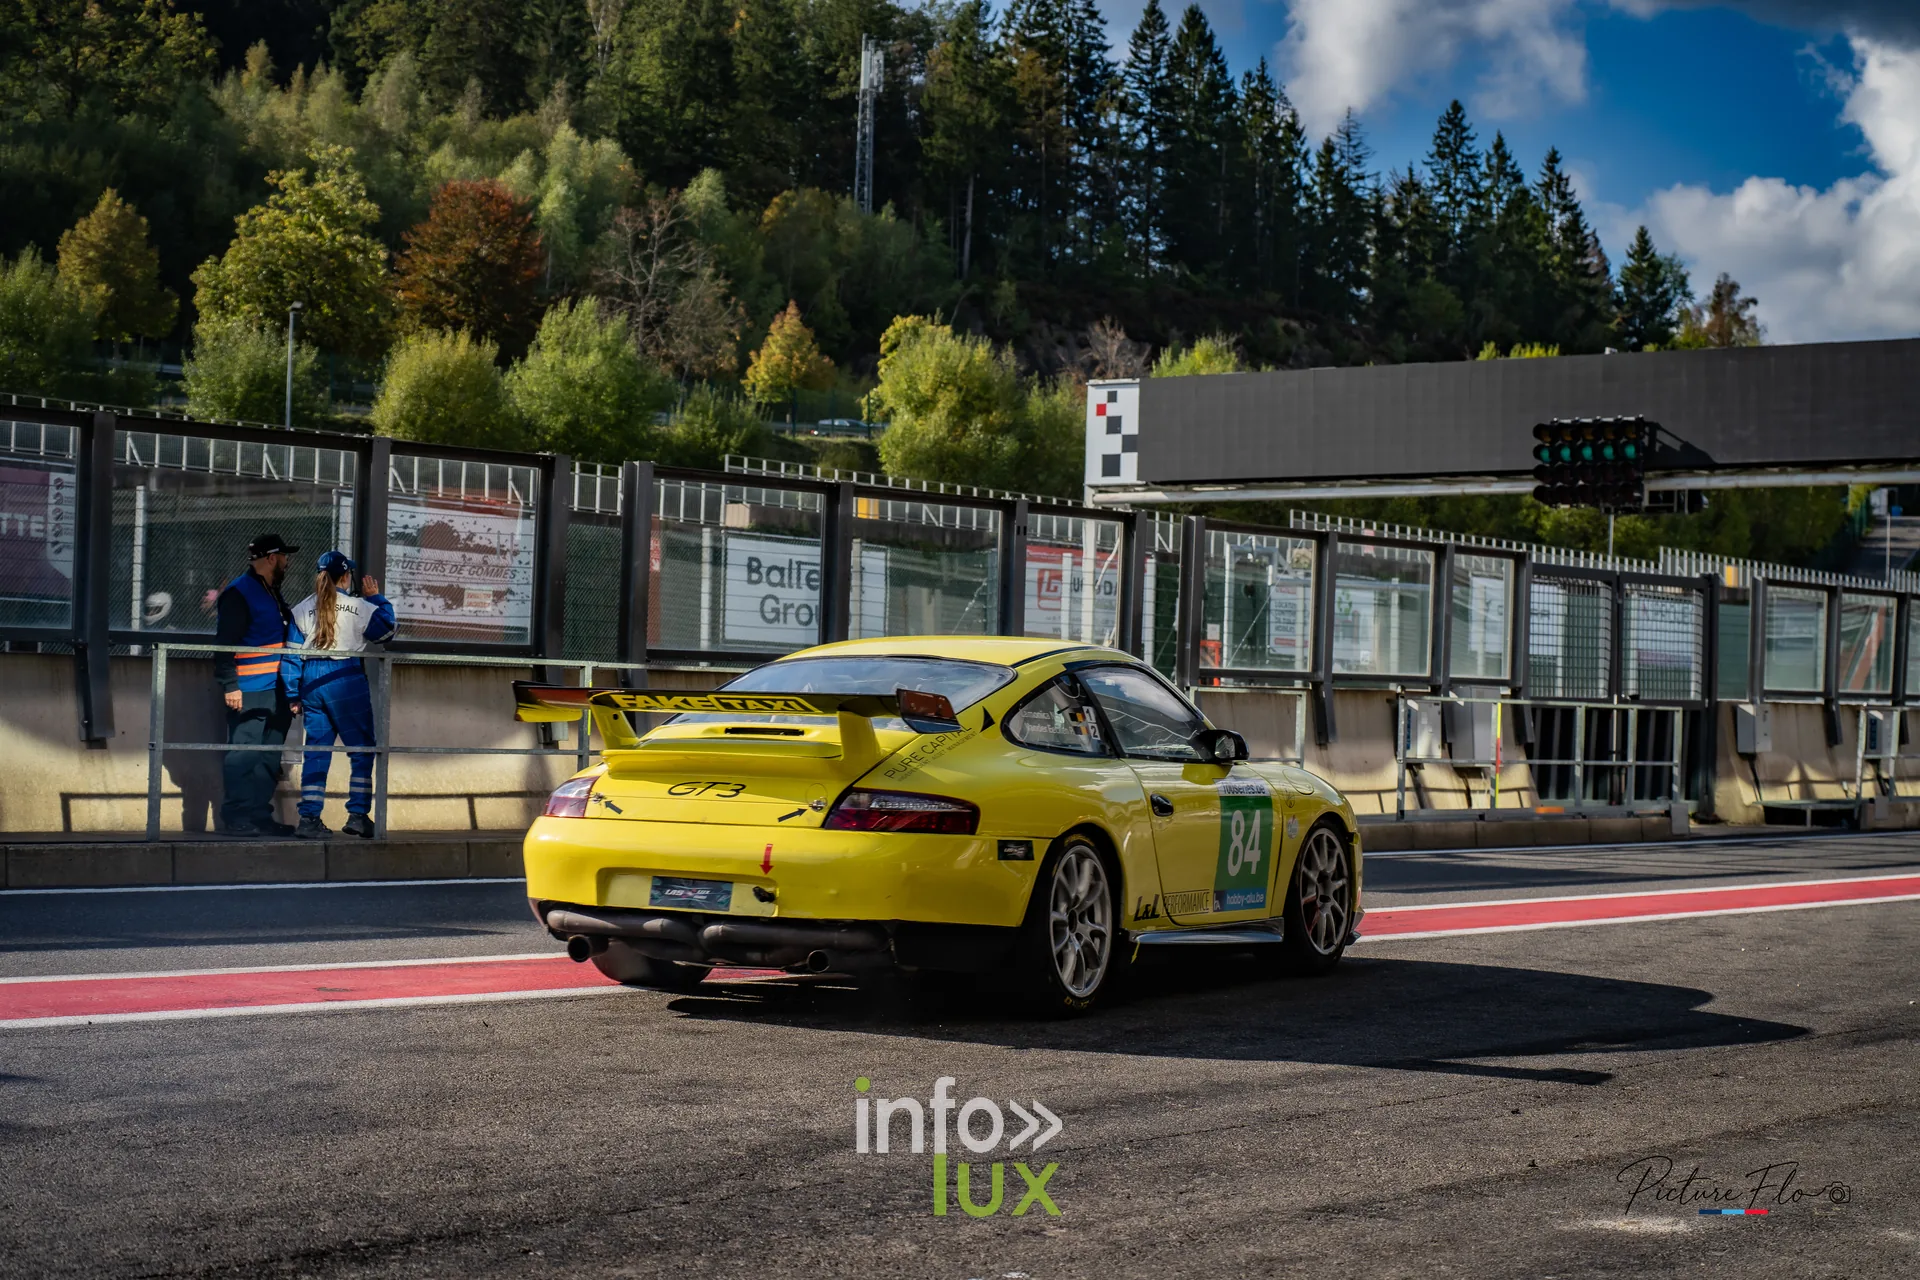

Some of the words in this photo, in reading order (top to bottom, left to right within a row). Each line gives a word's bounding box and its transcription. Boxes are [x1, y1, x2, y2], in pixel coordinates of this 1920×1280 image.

[449, 564, 465, 576] DE
[467, 566, 517, 580] GOMMES
[334, 603, 359, 616] SHALL
[609, 694, 717, 711] FAKE
[717, 699, 806, 712] TAXI
[1090, 725, 1099, 739] 2
[883, 751, 925, 779] PURE
[667, 781, 747, 798] GT3
[1227, 809, 1262, 877] 84
[1133, 893, 1161, 922] L&L
[1161, 891, 1210, 917] PERFORMANCE
[1226, 892, 1265, 906] hobby-alu.be
